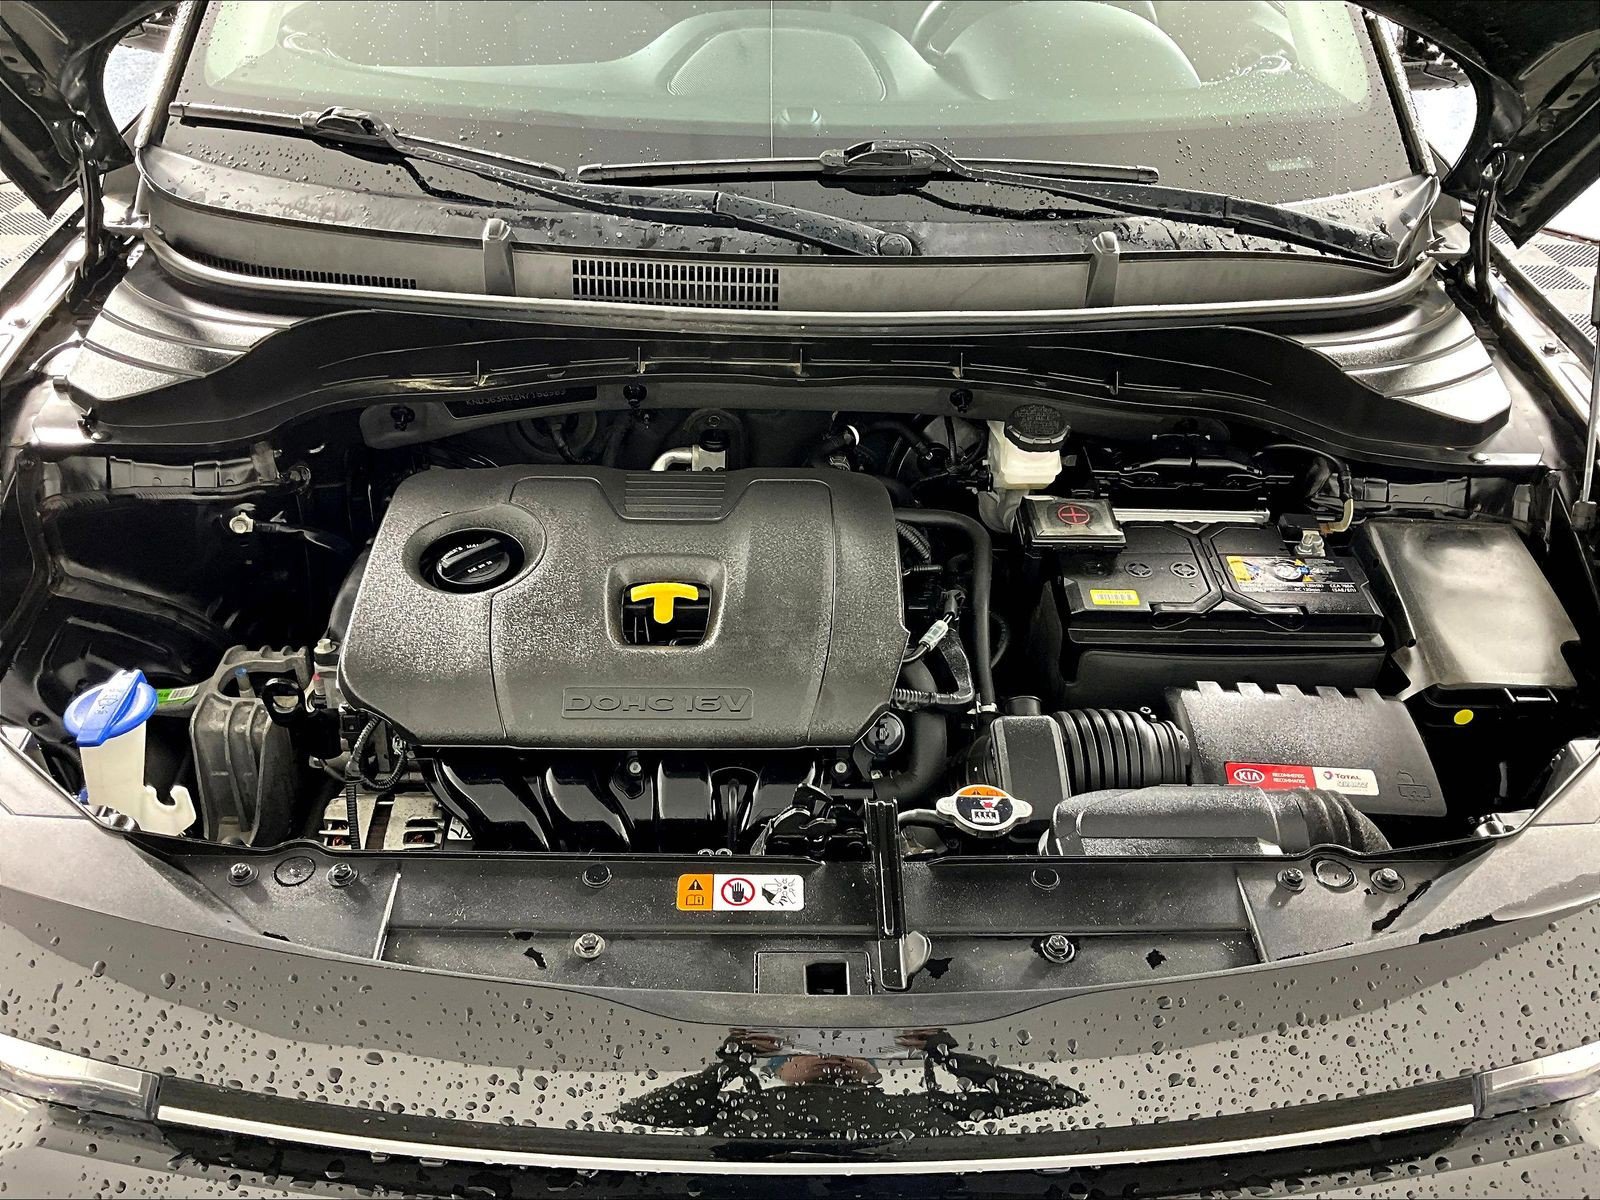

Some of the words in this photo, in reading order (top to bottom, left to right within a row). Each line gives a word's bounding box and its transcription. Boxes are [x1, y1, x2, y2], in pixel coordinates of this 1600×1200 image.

[565, 695, 675, 712] DOHC
[685, 695, 750, 713] 16V
[1238, 770, 1261, 782] KIA
[1335, 773, 1362, 781] TOTAL
